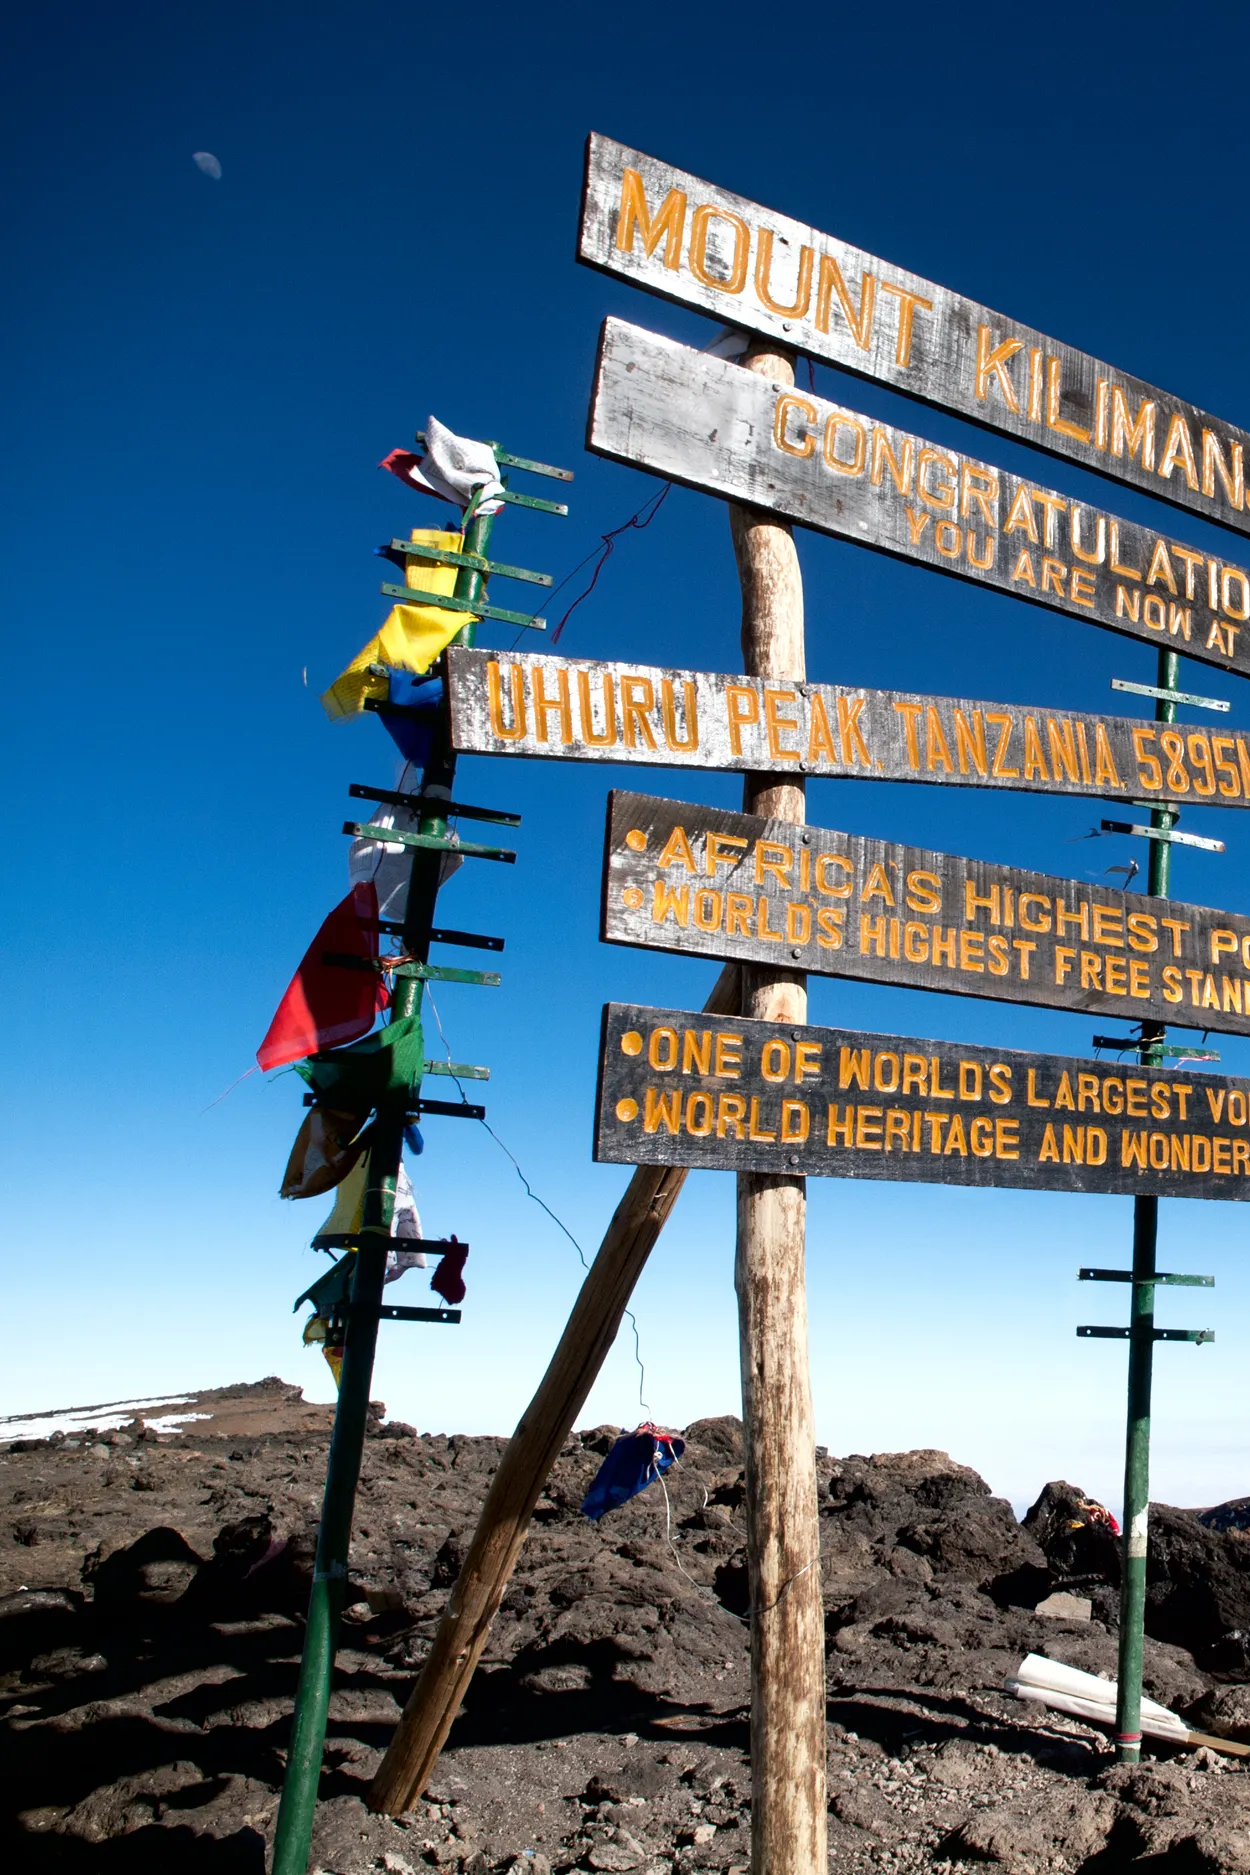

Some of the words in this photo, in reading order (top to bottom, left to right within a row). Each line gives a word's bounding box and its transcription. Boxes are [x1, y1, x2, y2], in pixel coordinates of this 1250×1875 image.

[615, 167, 932, 368] MOUNT
[904, 505, 995, 570] YOU
[1011, 548, 1096, 608] ARE
[1116, 583, 1191, 642] NOW
[1206, 619, 1240, 658] AT
[486, 660, 699, 753] UHURU
[860, 912, 1037, 980] HIGHEST
[1054, 945, 1150, 999] FREE
[964, 880, 1190, 958] HIGHEST
[648, 1026, 744, 1080] ONE
[761, 1038, 822, 1084] OF
[1027, 1067, 1193, 1121] LARGEST
[643, 1087, 810, 1144] WORLD
[827, 1104, 1020, 1161] HERITAGE
[1038, 1122, 1108, 1167] AND
